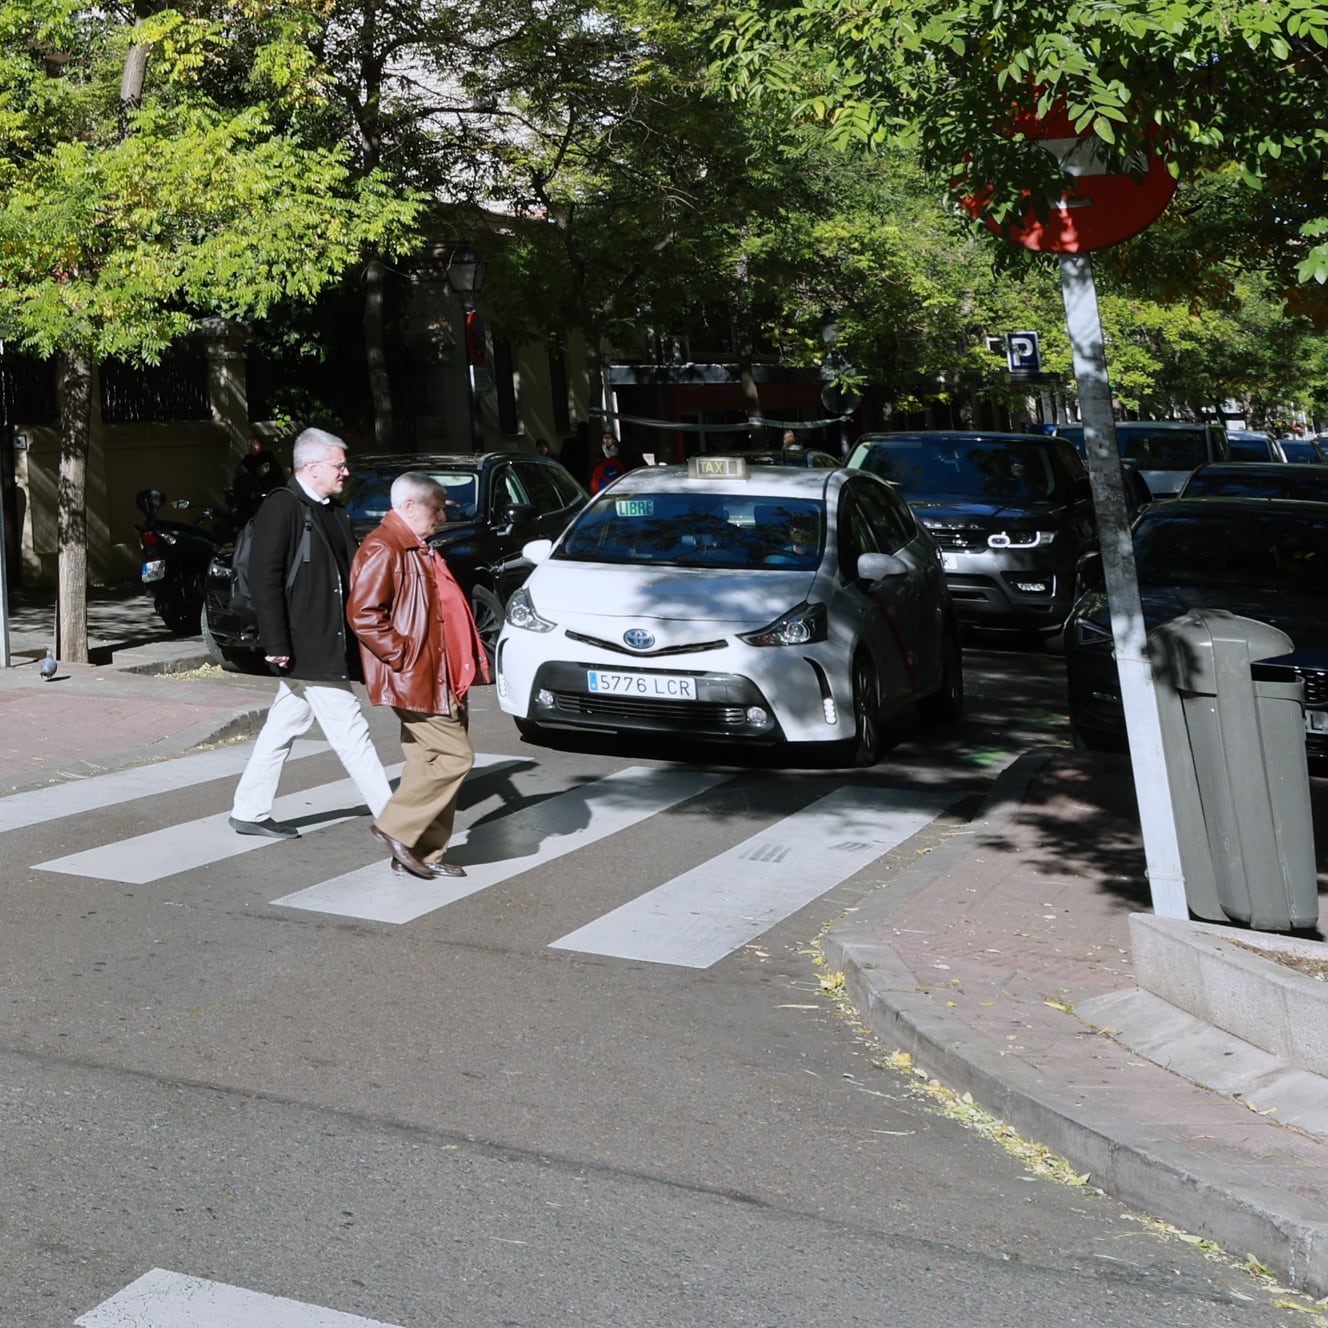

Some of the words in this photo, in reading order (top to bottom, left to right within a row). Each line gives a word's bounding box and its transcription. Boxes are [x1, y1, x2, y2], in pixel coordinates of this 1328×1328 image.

[1011, 337, 1034, 366] P
[699, 461, 726, 474] TAXI
[618, 502, 653, 515] LIBRE
[600, 674, 647, 693] 5776
[654, 678, 690, 697] LCR
